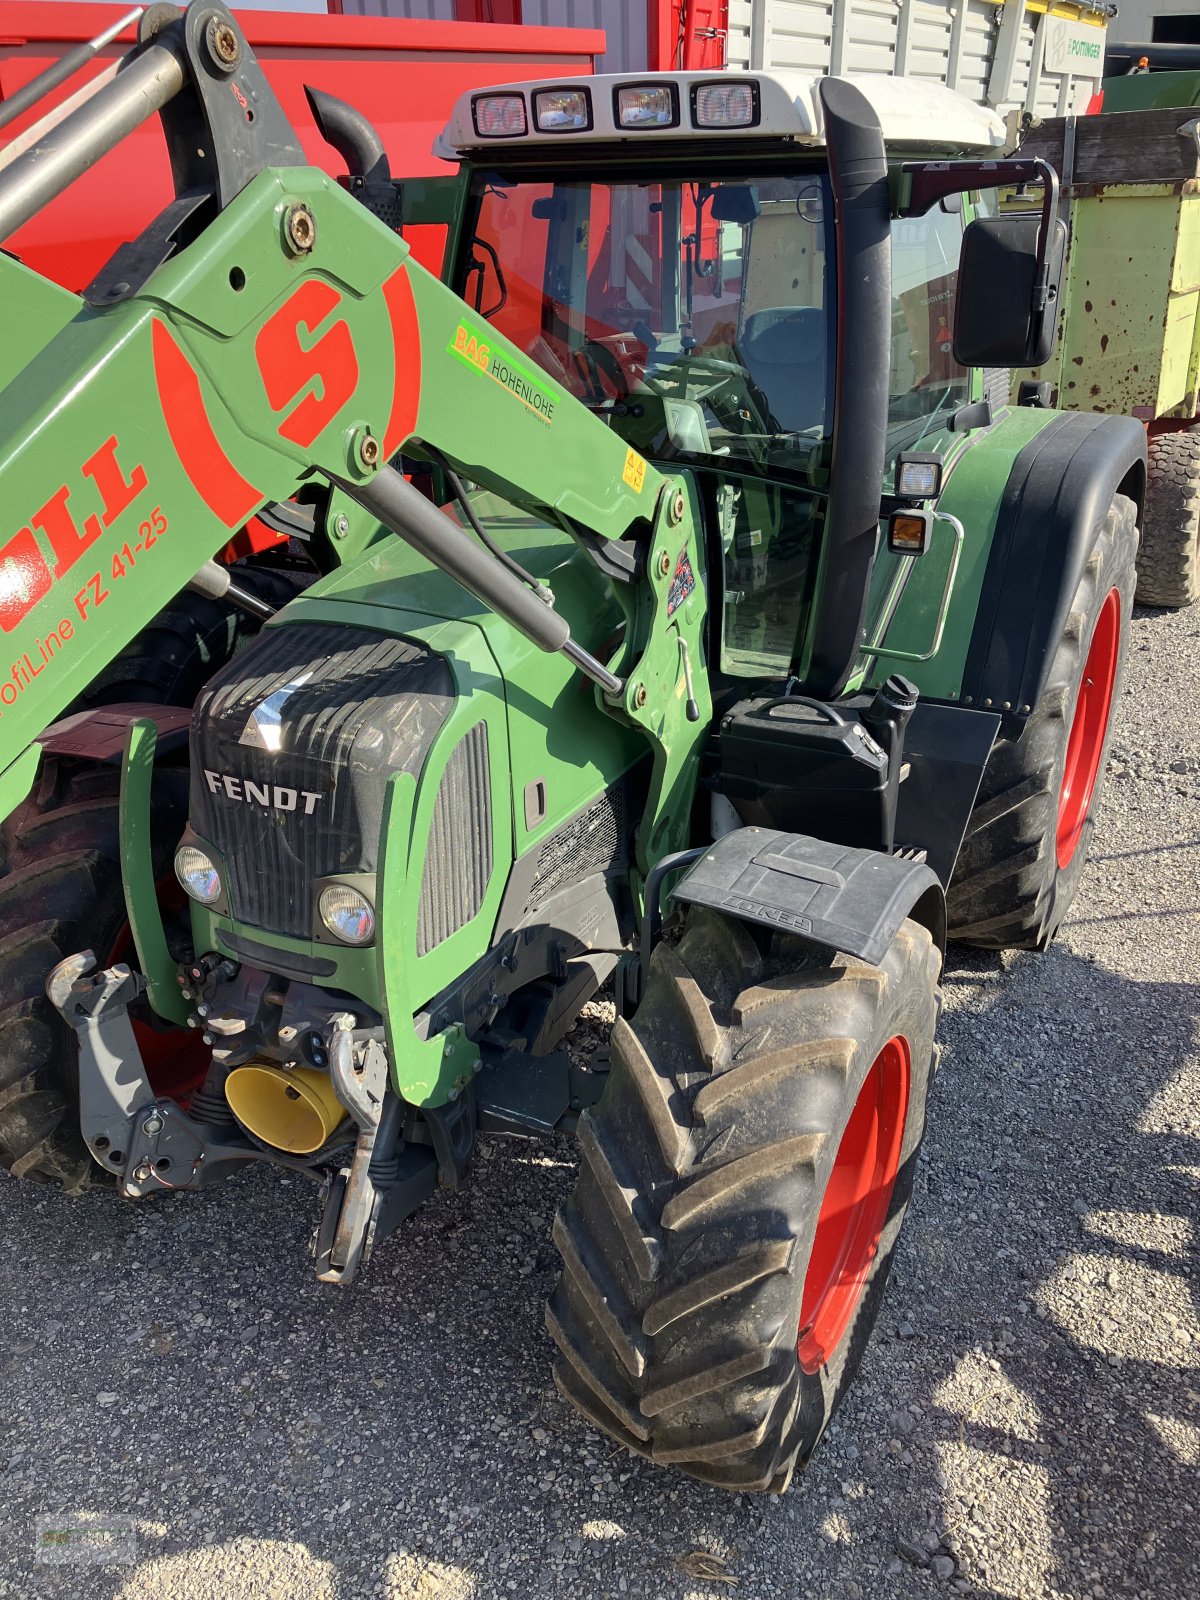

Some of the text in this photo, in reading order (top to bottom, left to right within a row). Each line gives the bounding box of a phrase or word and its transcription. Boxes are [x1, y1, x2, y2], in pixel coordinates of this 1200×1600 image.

[454, 324, 491, 371] BAG
[491, 359, 555, 420] HOHENLOHE
[0, 617, 76, 717] ofiLine
[73, 571, 110, 622] FZ
[111, 505, 169, 581] 41-25
[203, 769, 323, 815] FENDT
